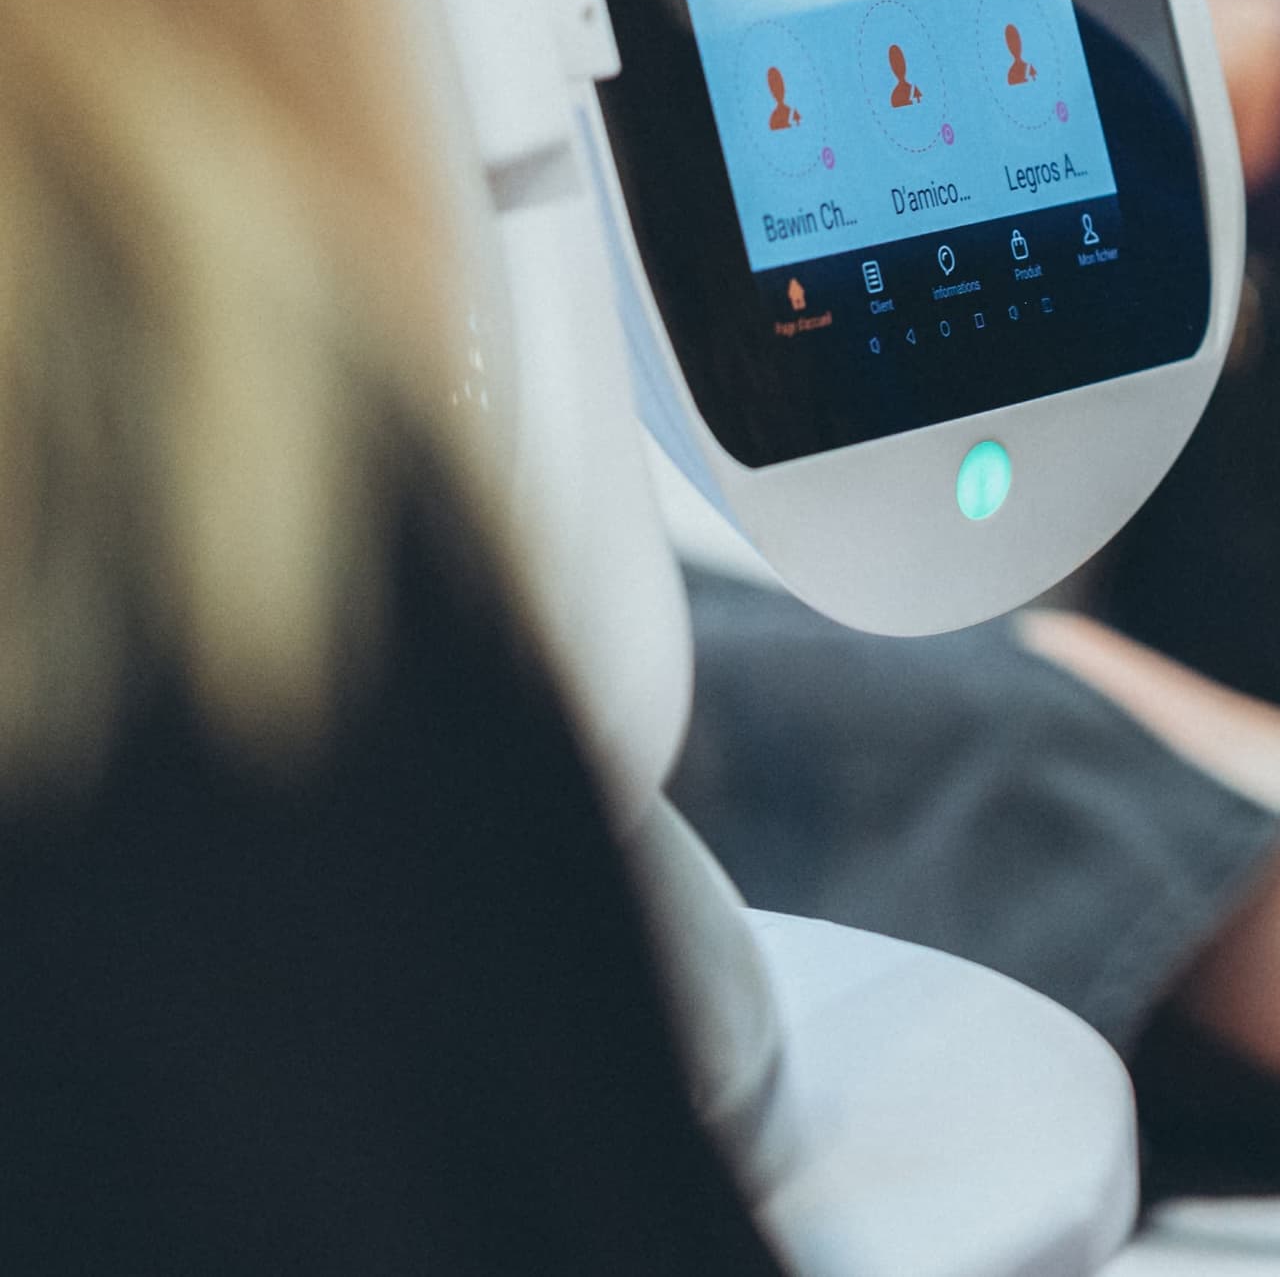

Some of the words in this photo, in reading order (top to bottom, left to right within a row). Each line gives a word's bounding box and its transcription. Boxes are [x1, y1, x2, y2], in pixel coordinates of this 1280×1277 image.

[1005, 161, 1061, 195] Legros
[763, 209, 818, 243] Bawin
[1014, 264, 1043, 281] Produit
[870, 298, 895, 315] Client
